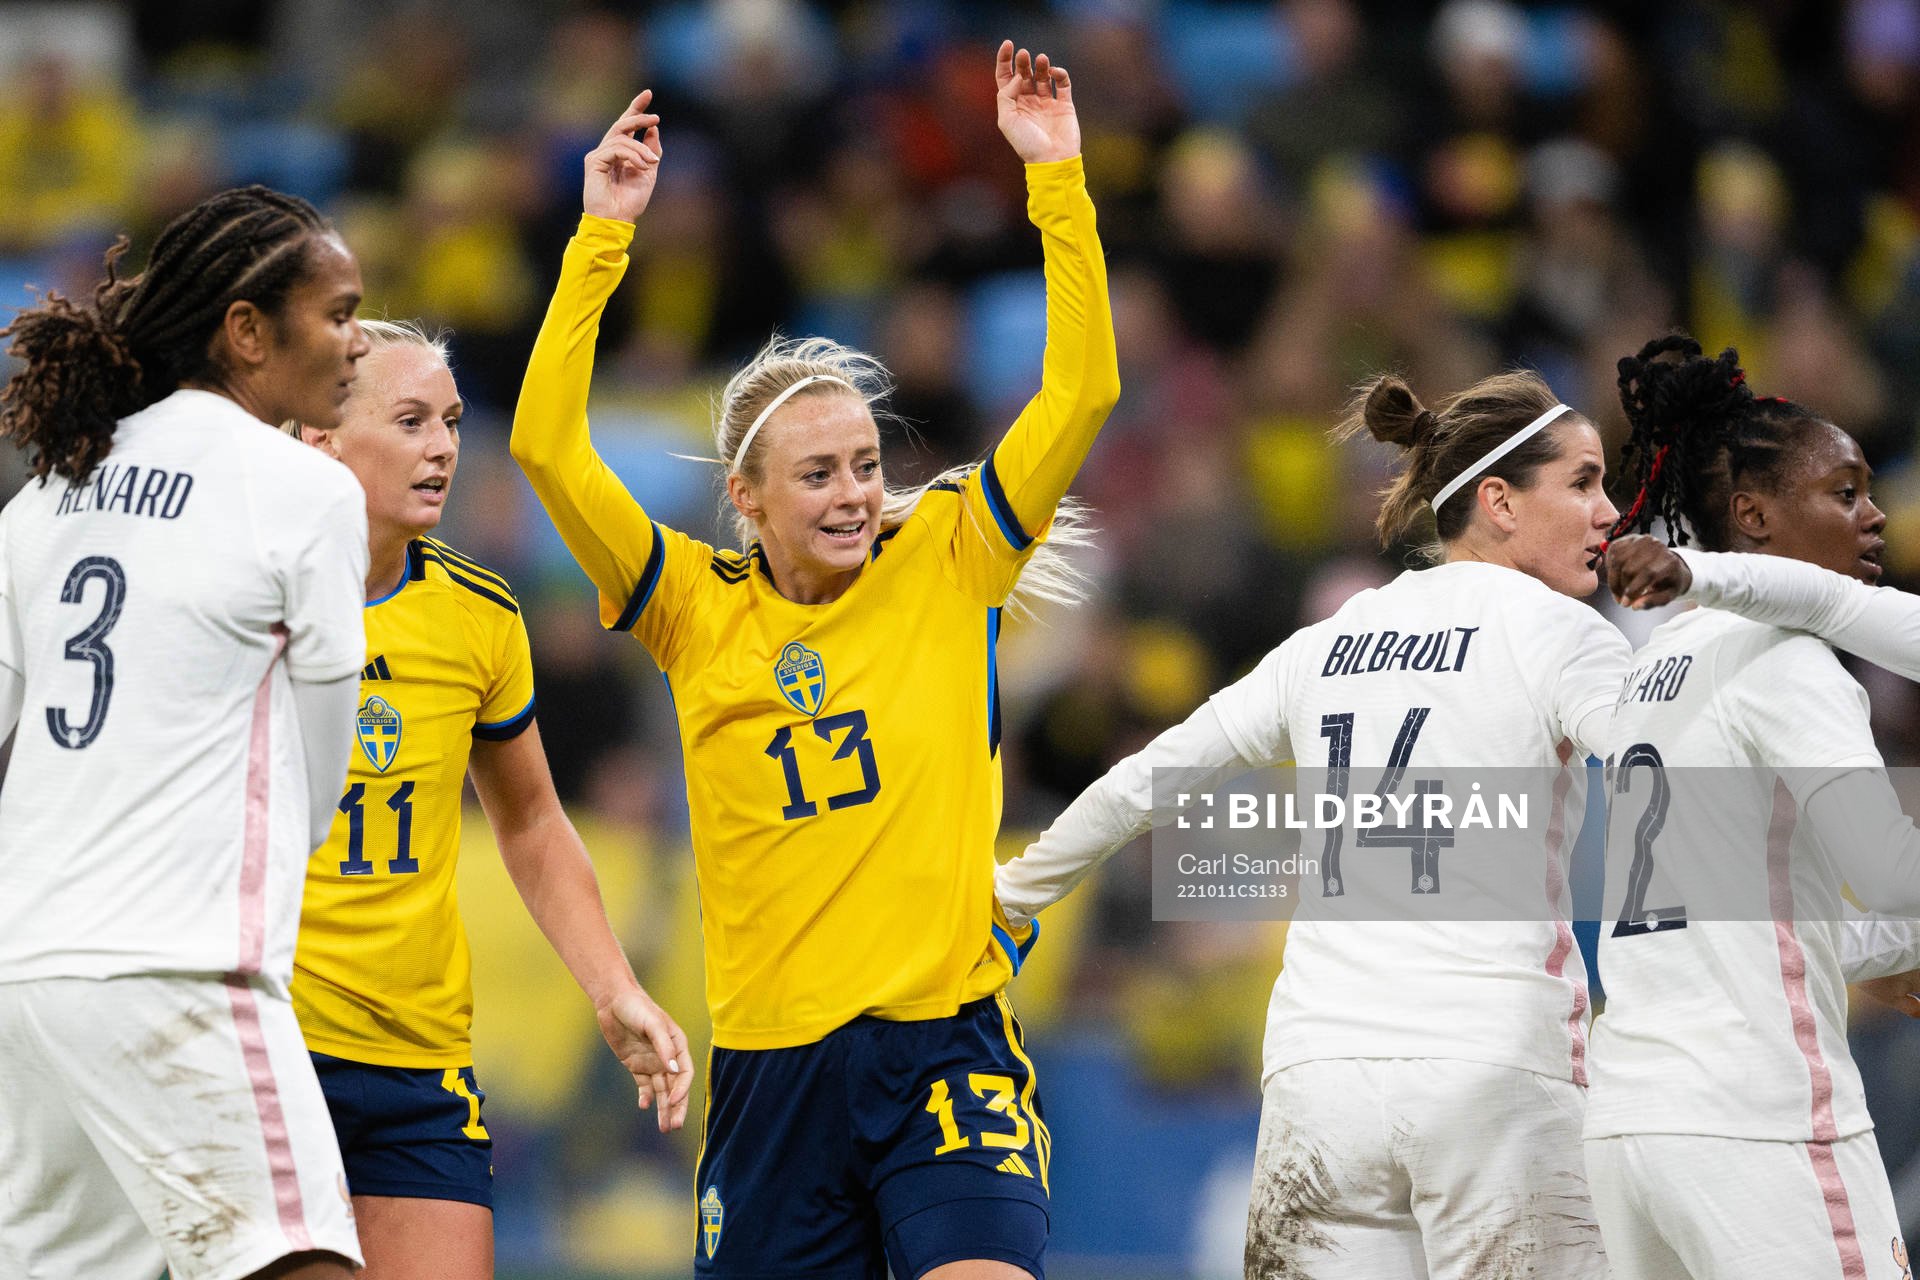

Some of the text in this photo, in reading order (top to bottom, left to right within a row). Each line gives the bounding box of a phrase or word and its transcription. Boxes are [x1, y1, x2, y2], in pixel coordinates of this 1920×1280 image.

[46, 556, 126, 749] 3
[1321, 626, 1479, 677] BILBAULT
[1614, 655, 1693, 715] ARD
[765, 709, 881, 821] 13
[1320, 707, 1455, 898] 14
[338, 781, 419, 875] 11
[925, 1073, 1030, 1156] 13
